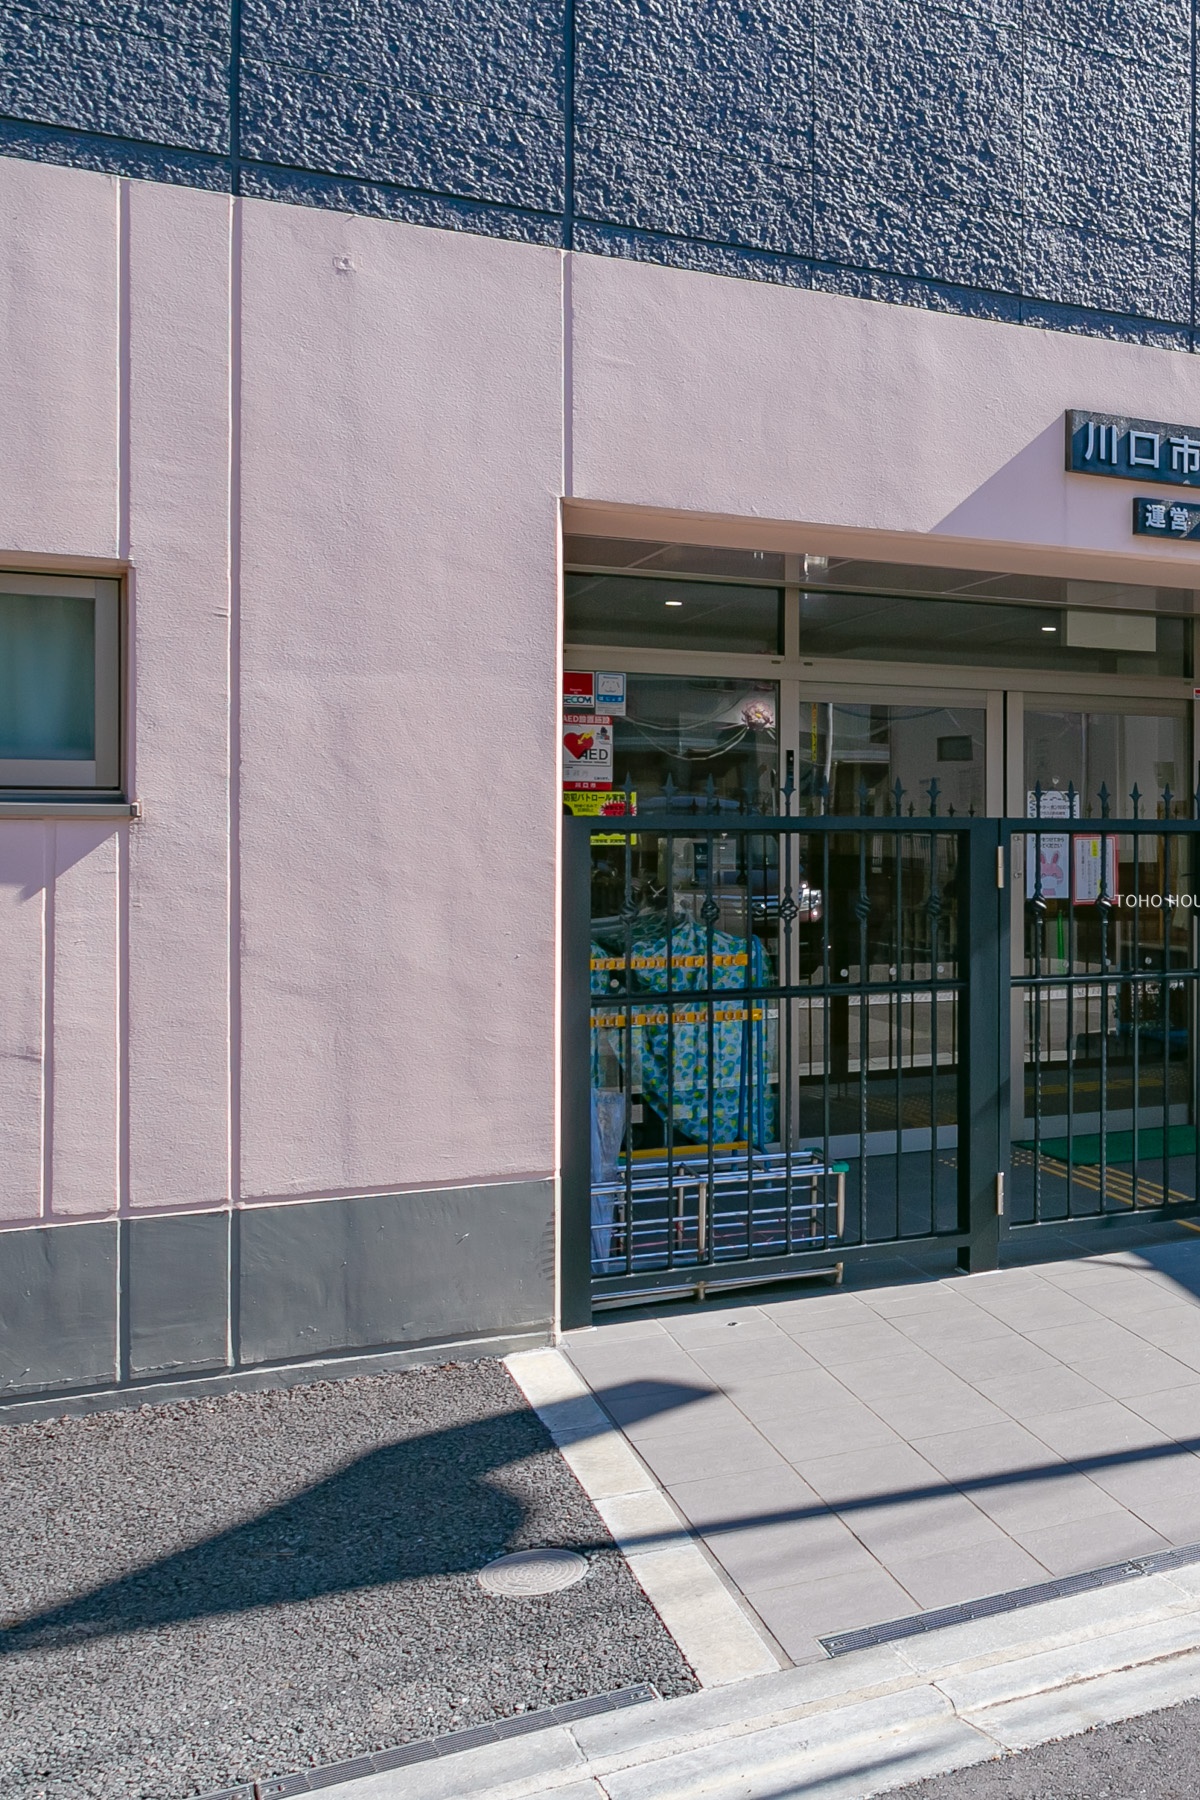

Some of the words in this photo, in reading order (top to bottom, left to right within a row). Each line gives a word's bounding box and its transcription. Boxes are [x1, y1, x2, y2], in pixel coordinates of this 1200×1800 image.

[1145, 503, 1189, 532] 運営
[578, 748, 609, 761] AED
[563, 793, 632, 802] 防犯パトロール実施
